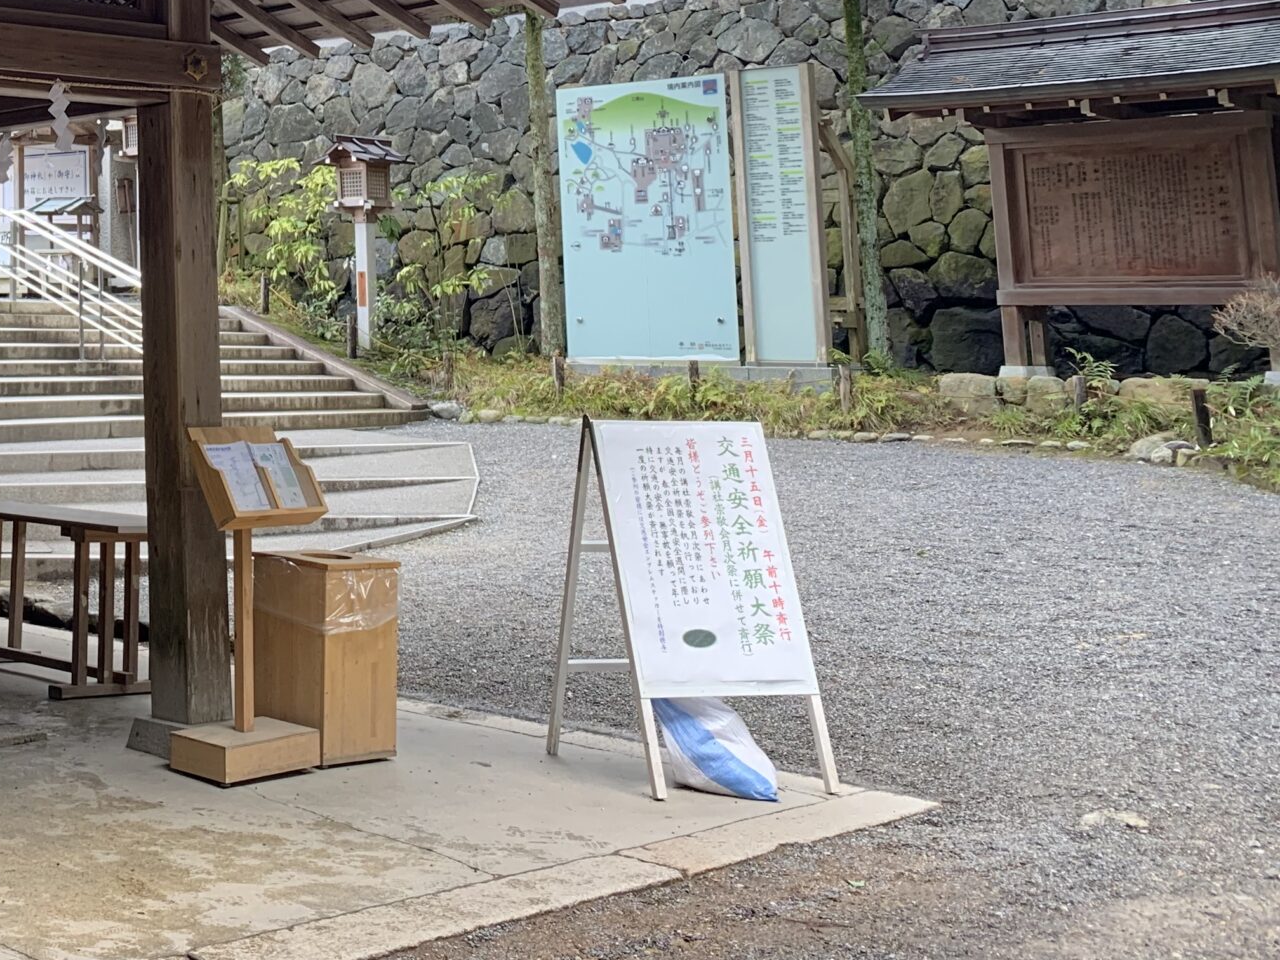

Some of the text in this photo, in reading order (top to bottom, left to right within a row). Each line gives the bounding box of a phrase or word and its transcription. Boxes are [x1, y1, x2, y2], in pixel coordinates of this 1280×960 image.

[716, 435, 776, 646] 交通安全祈願大祭
